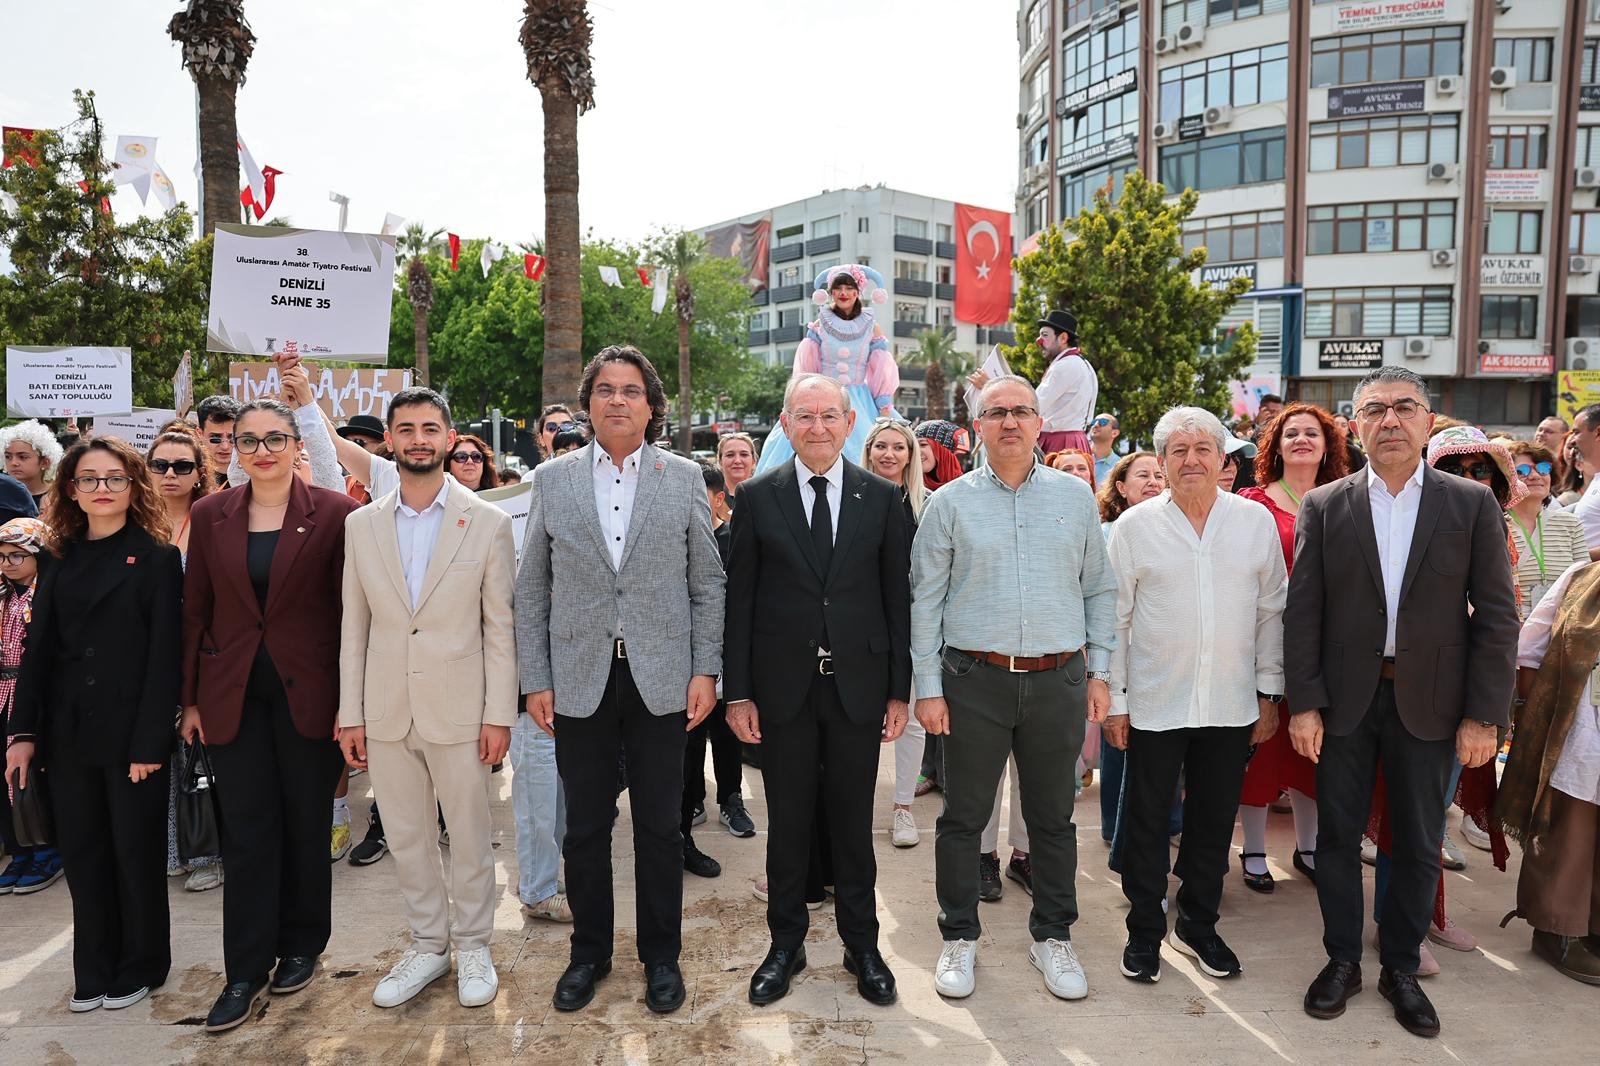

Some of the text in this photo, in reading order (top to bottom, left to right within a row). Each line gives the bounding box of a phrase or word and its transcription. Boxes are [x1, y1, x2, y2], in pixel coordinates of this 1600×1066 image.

[1364, 92, 1403, 103] AVUKAT
[236, 256, 372, 273] Uluslararası Amatör Tiyatro Festivali
[1482, 259, 1533, 269] AVUKAT
[1203, 265, 1254, 281] AVUKAT
[279, 277, 325, 291] DENİZLİ
[270, 294, 331, 309] SAHNE 35
[1323, 342, 1382, 354] AVUKAT
[52, 382, 112, 390] EDEBİYATLARI
[62, 392, 112, 400] TOPLULUĞU
